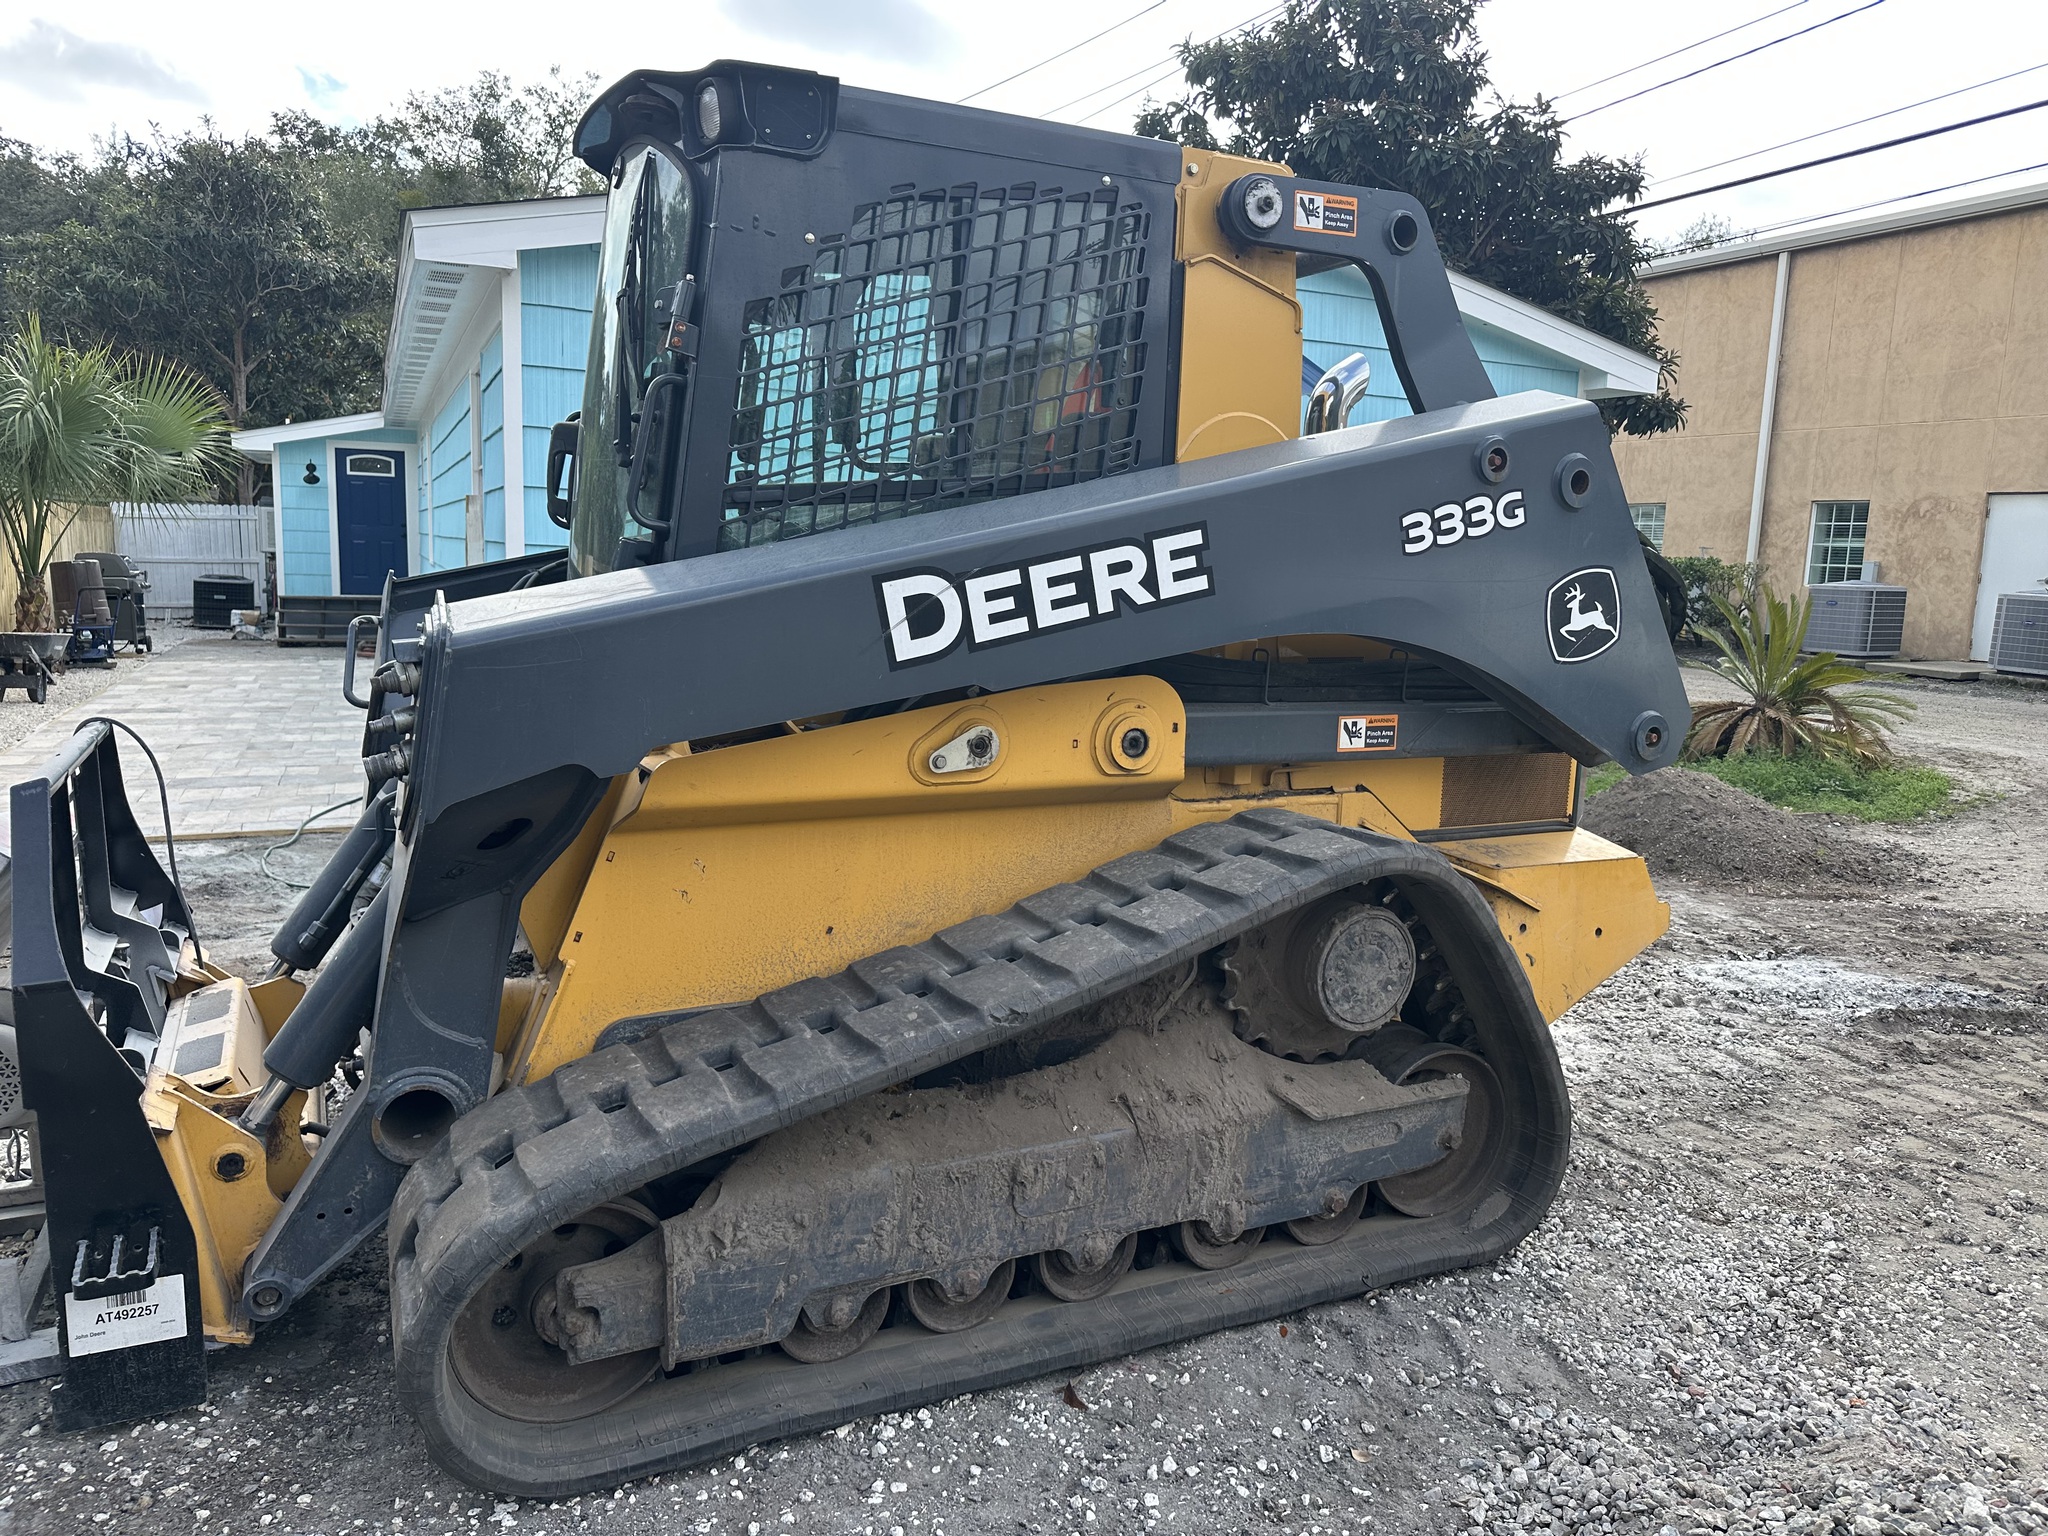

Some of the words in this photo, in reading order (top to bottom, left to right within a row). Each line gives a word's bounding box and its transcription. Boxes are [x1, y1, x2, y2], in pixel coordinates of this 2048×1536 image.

[1331, 197, 1354, 207] WARNING
[1325, 211, 1340, 219] Pinch
[1340, 213, 1353, 221] Area
[1337, 221, 1349, 229] Away
[1402, 491, 1525, 554] 333G
[882, 529, 1208, 662] DEERE
[95, 1304, 160, 1325] AT492257
[74, 1332, 89, 1341] John
[90, 1330, 106, 1338] Deere
